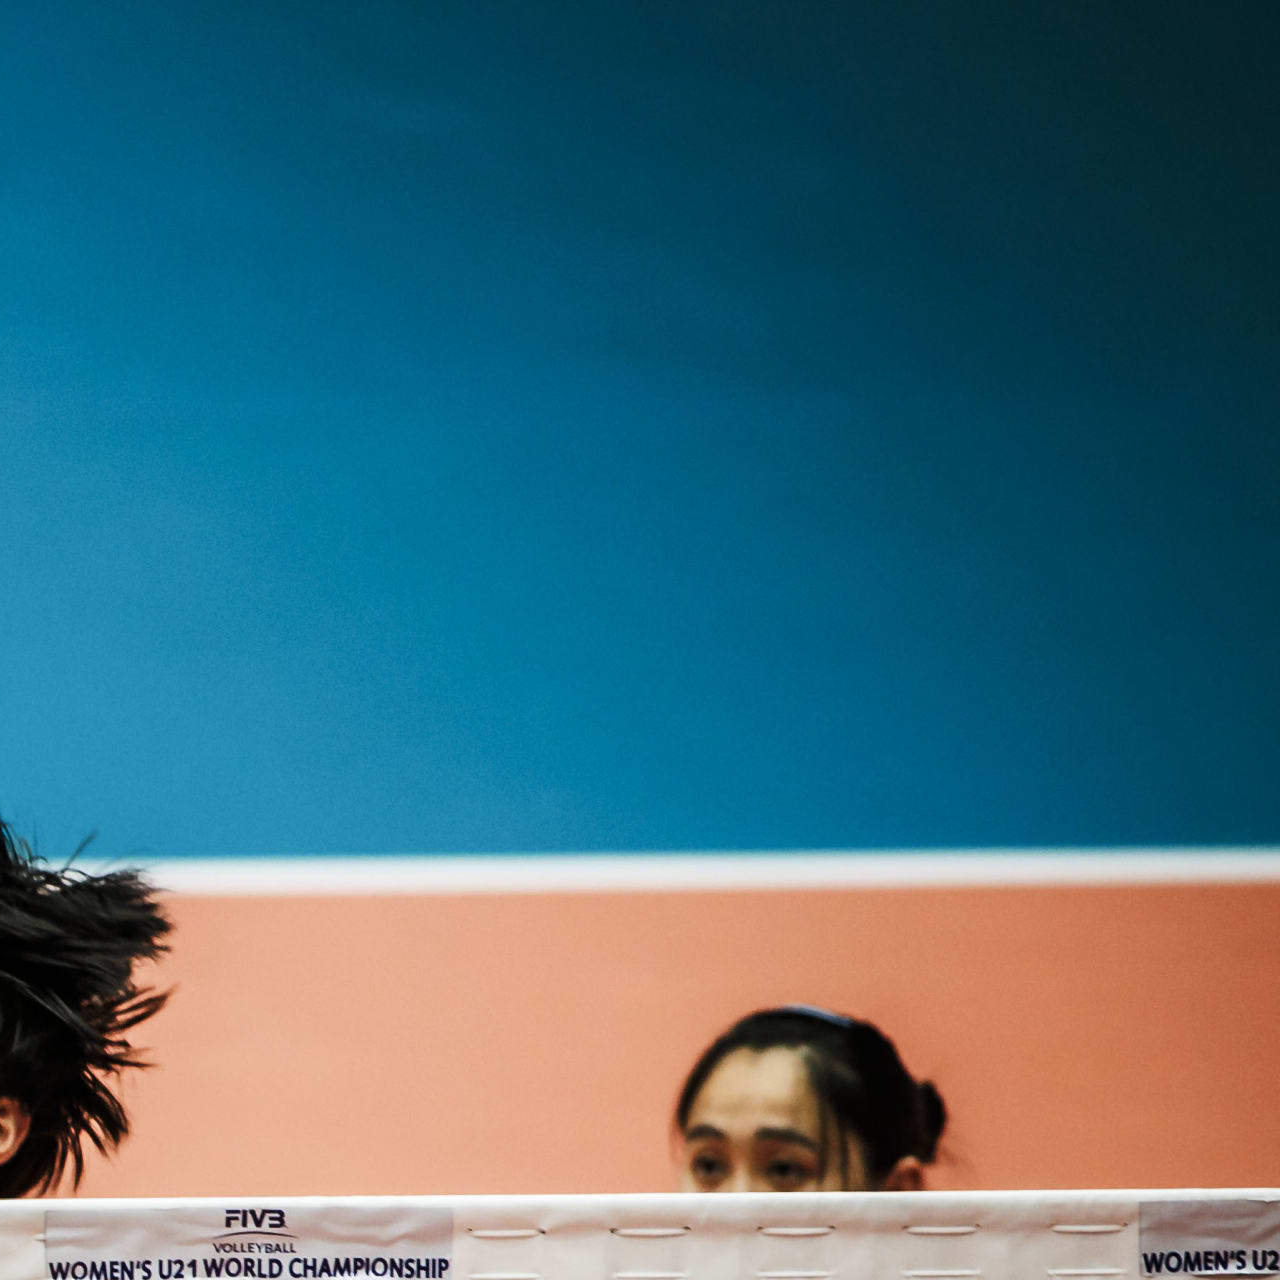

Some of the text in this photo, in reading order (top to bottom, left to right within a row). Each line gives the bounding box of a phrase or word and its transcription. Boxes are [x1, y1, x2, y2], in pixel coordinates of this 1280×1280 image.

[225, 1208, 287, 1229] FIVB
[213, 1242, 297, 1254] VOLLEYBALL
[158, 1258, 197, 1280] U21
[202, 1257, 284, 1279] WORLD
[288, 1257, 450, 1279] CHAMPIONSHIP
[1142, 1249, 1247, 1273] WOMEN'S
